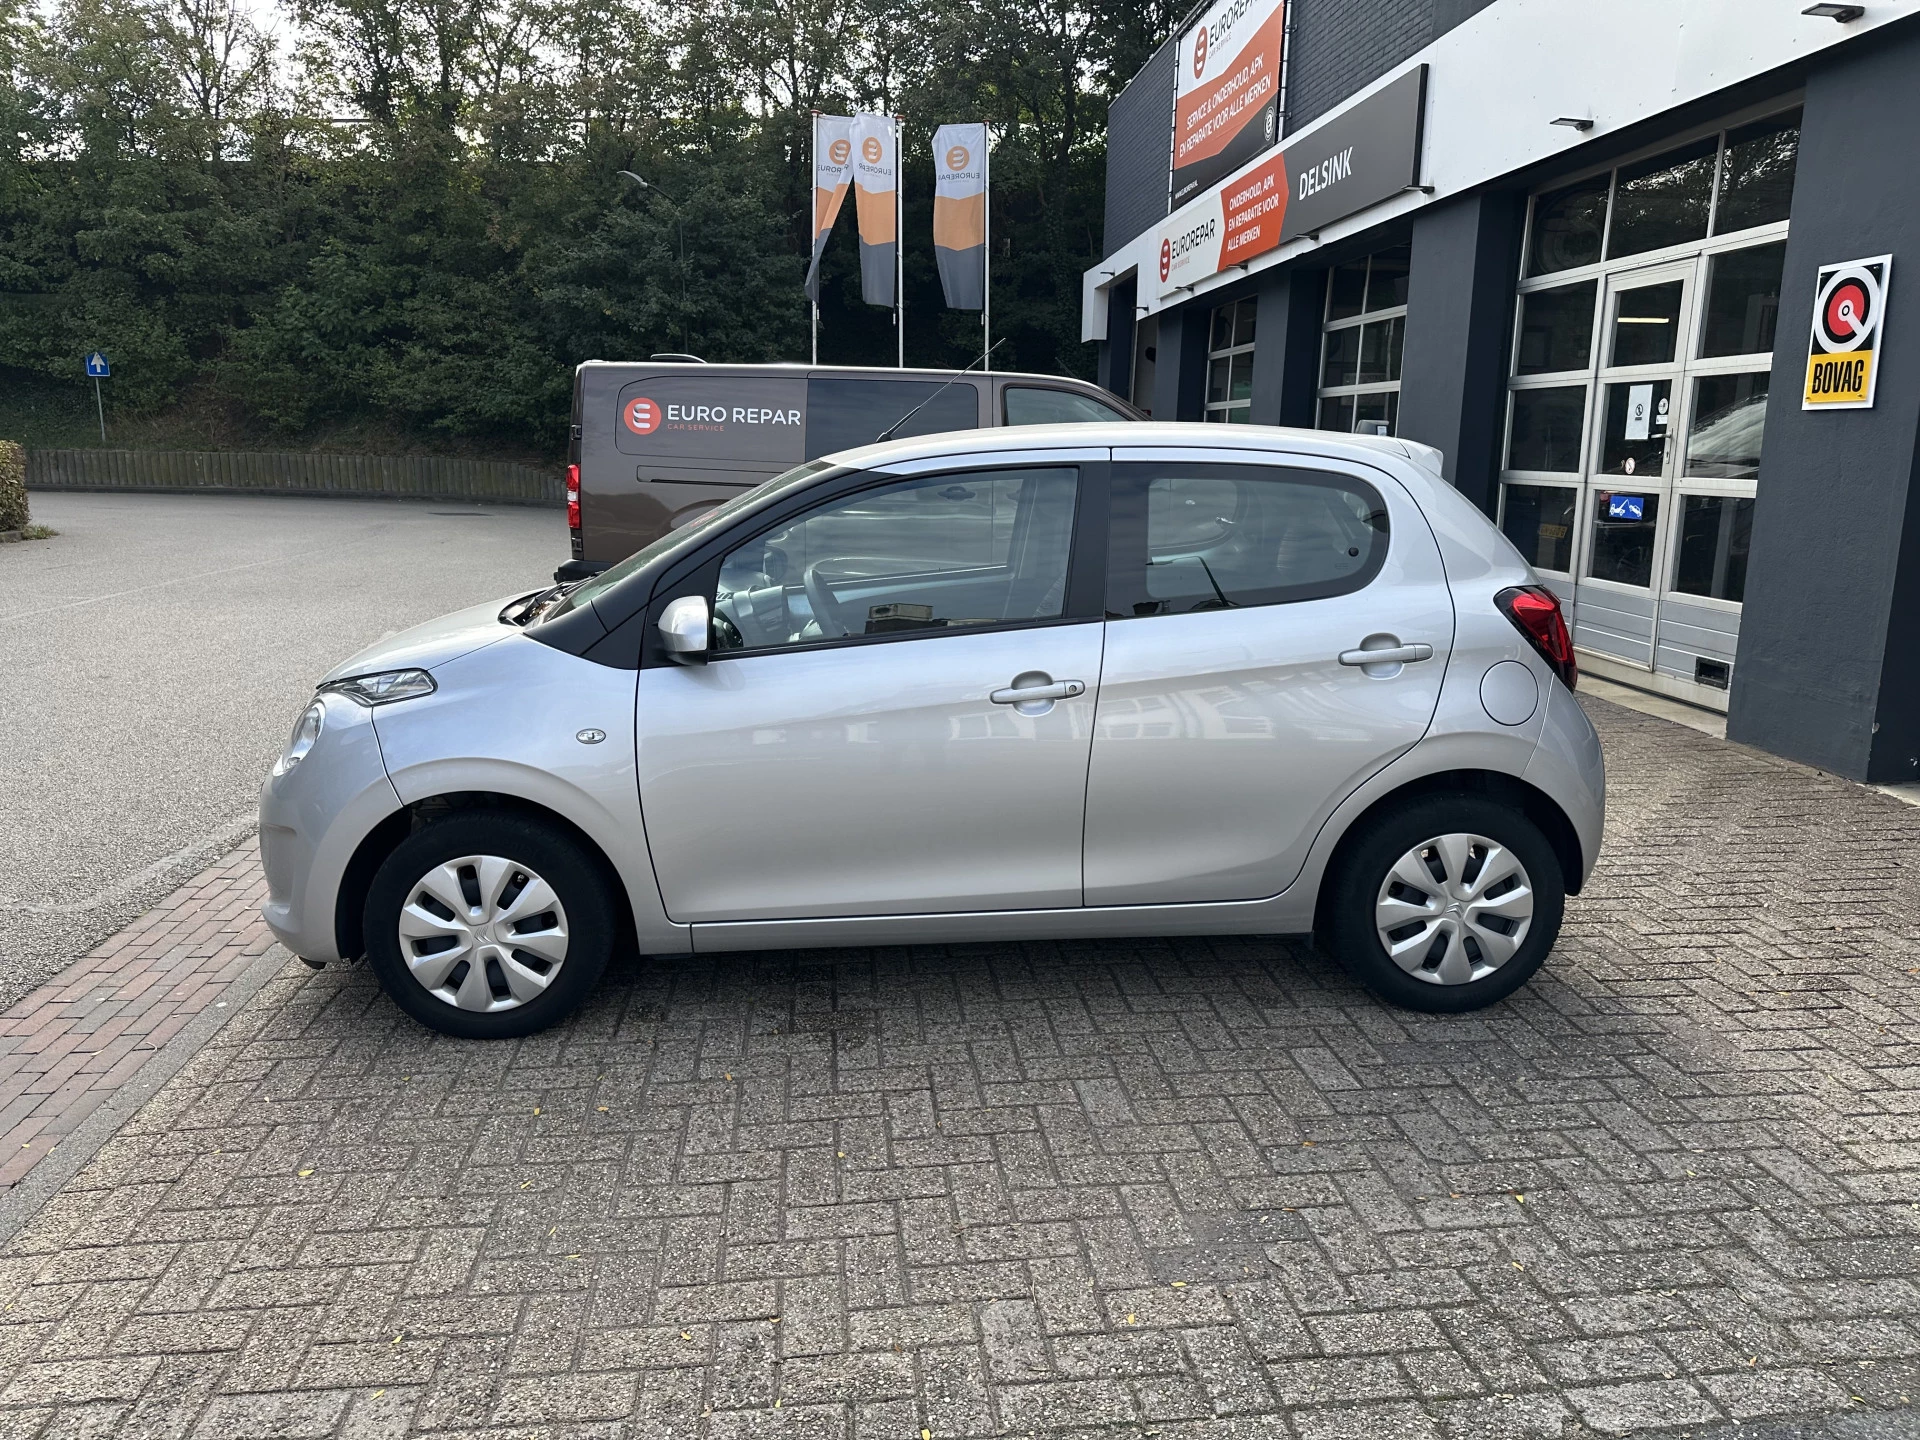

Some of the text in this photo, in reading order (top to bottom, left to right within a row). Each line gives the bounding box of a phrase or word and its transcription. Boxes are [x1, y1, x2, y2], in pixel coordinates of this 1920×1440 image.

[1186, 52, 1264, 130] SERVICE & ONDERHOUD, APK
[1179, 72, 1272, 158] EN REPARATIE VOOR ALLE MERKEN
[1229, 174, 1275, 211] ONDERHOUD, APK
[1299, 146, 1354, 201] DELSINK
[1228, 193, 1279, 232] EN REPARATIE VOOR
[1171, 218, 1216, 259] EUROREPAR
[1227, 225, 1261, 252] ALLE MERKEN
[1811, 359, 1865, 394] BOVAG
[667, 404, 801, 426] EURO REPAR
[688, 424, 725, 432] SERVICE
